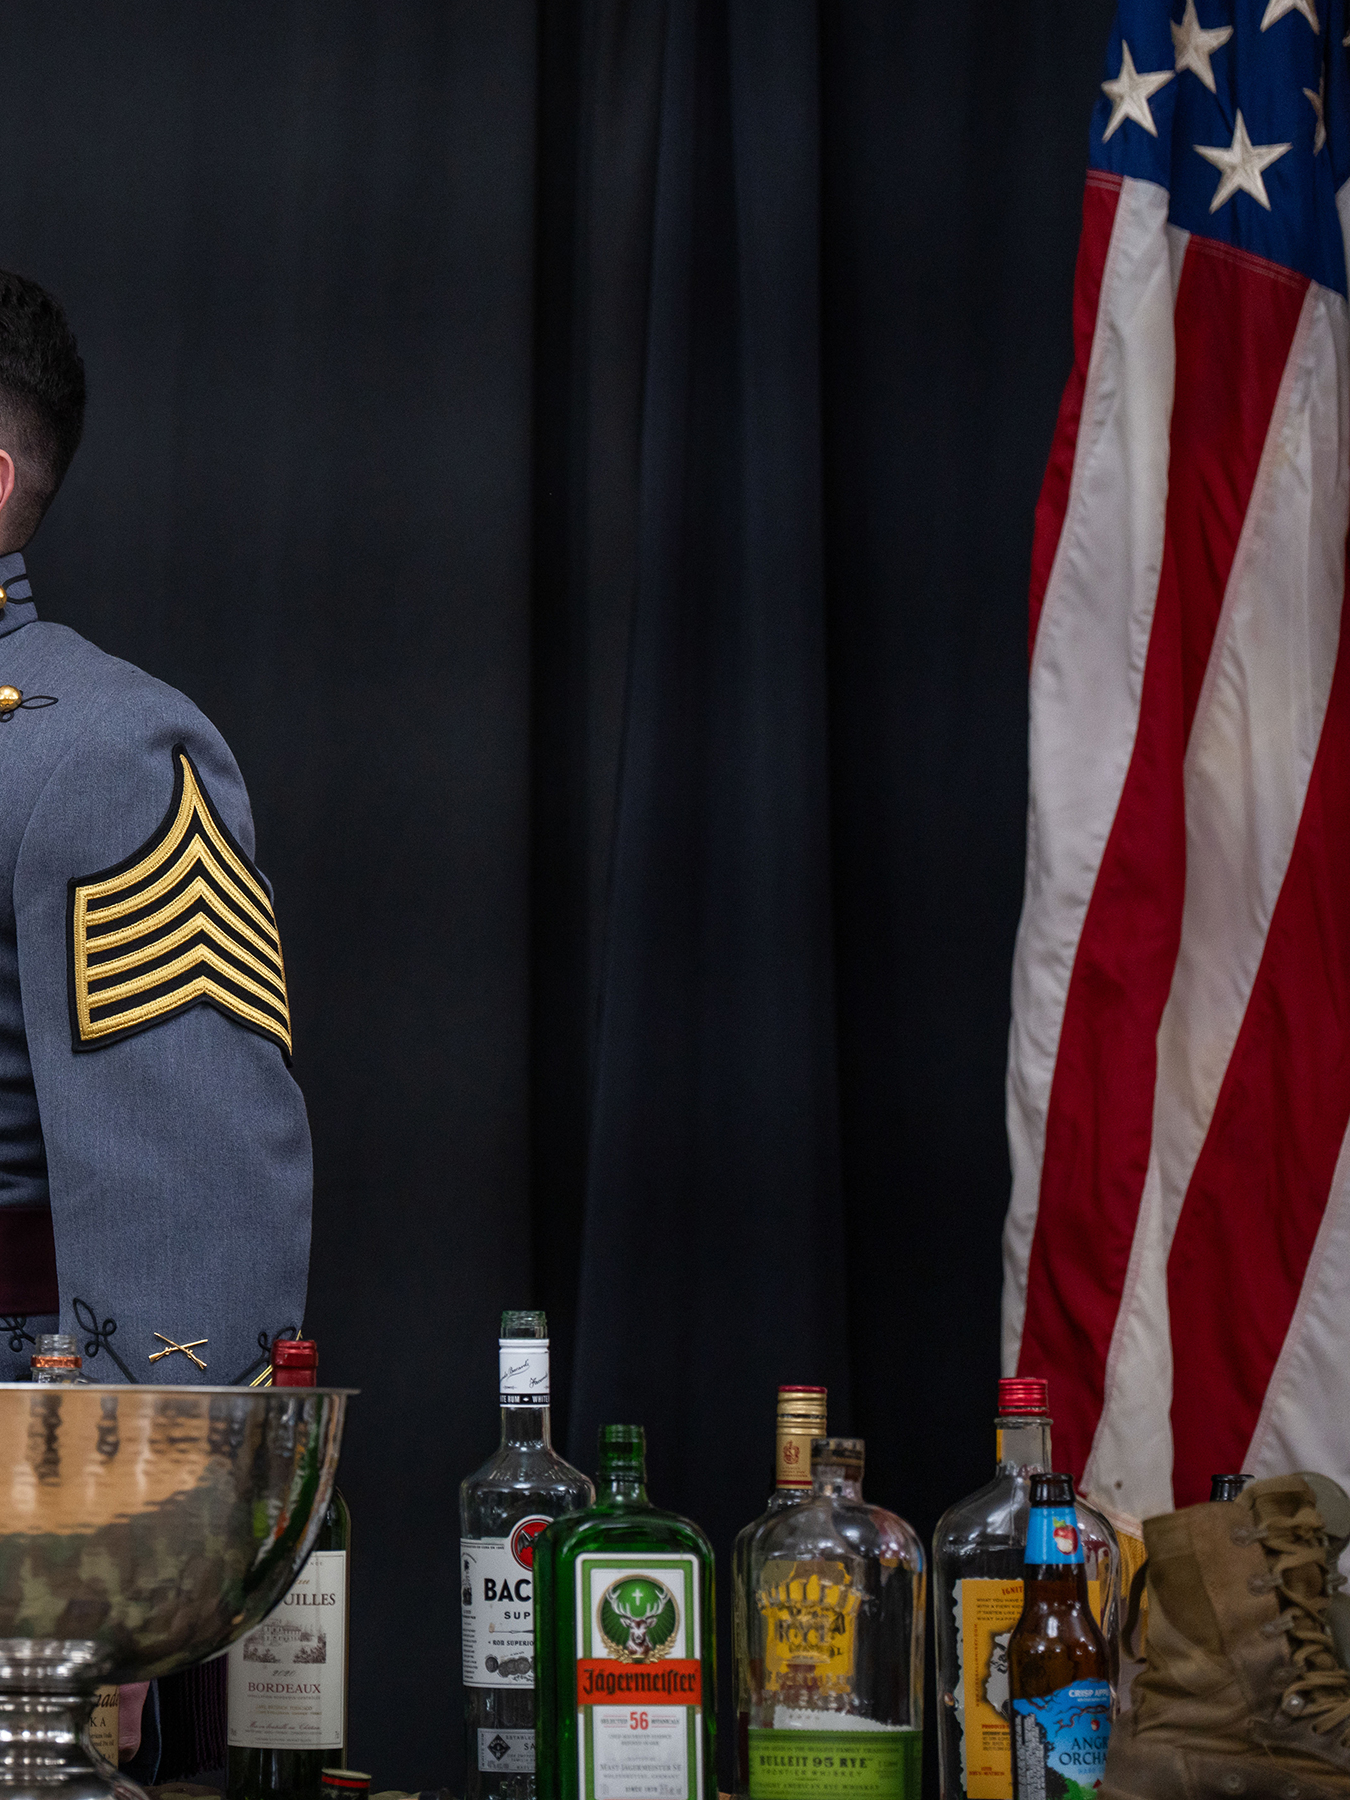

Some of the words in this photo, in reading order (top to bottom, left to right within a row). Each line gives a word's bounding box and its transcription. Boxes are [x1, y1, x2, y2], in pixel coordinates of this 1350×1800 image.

[507, 1395, 520, 1403] RUM
[484, 1577, 532, 1602] BAC
[504, 1611, 531, 1620] SUP
[248, 1682, 321, 1694] BORDEAUX
[1068, 1689, 1094, 1697] CRISP
[630, 1711, 649, 1730] 56
[759, 1755, 809, 1768] BULLEIT
[811, 1756, 835, 1768] 95
[838, 1757, 869, 1769] RYE
